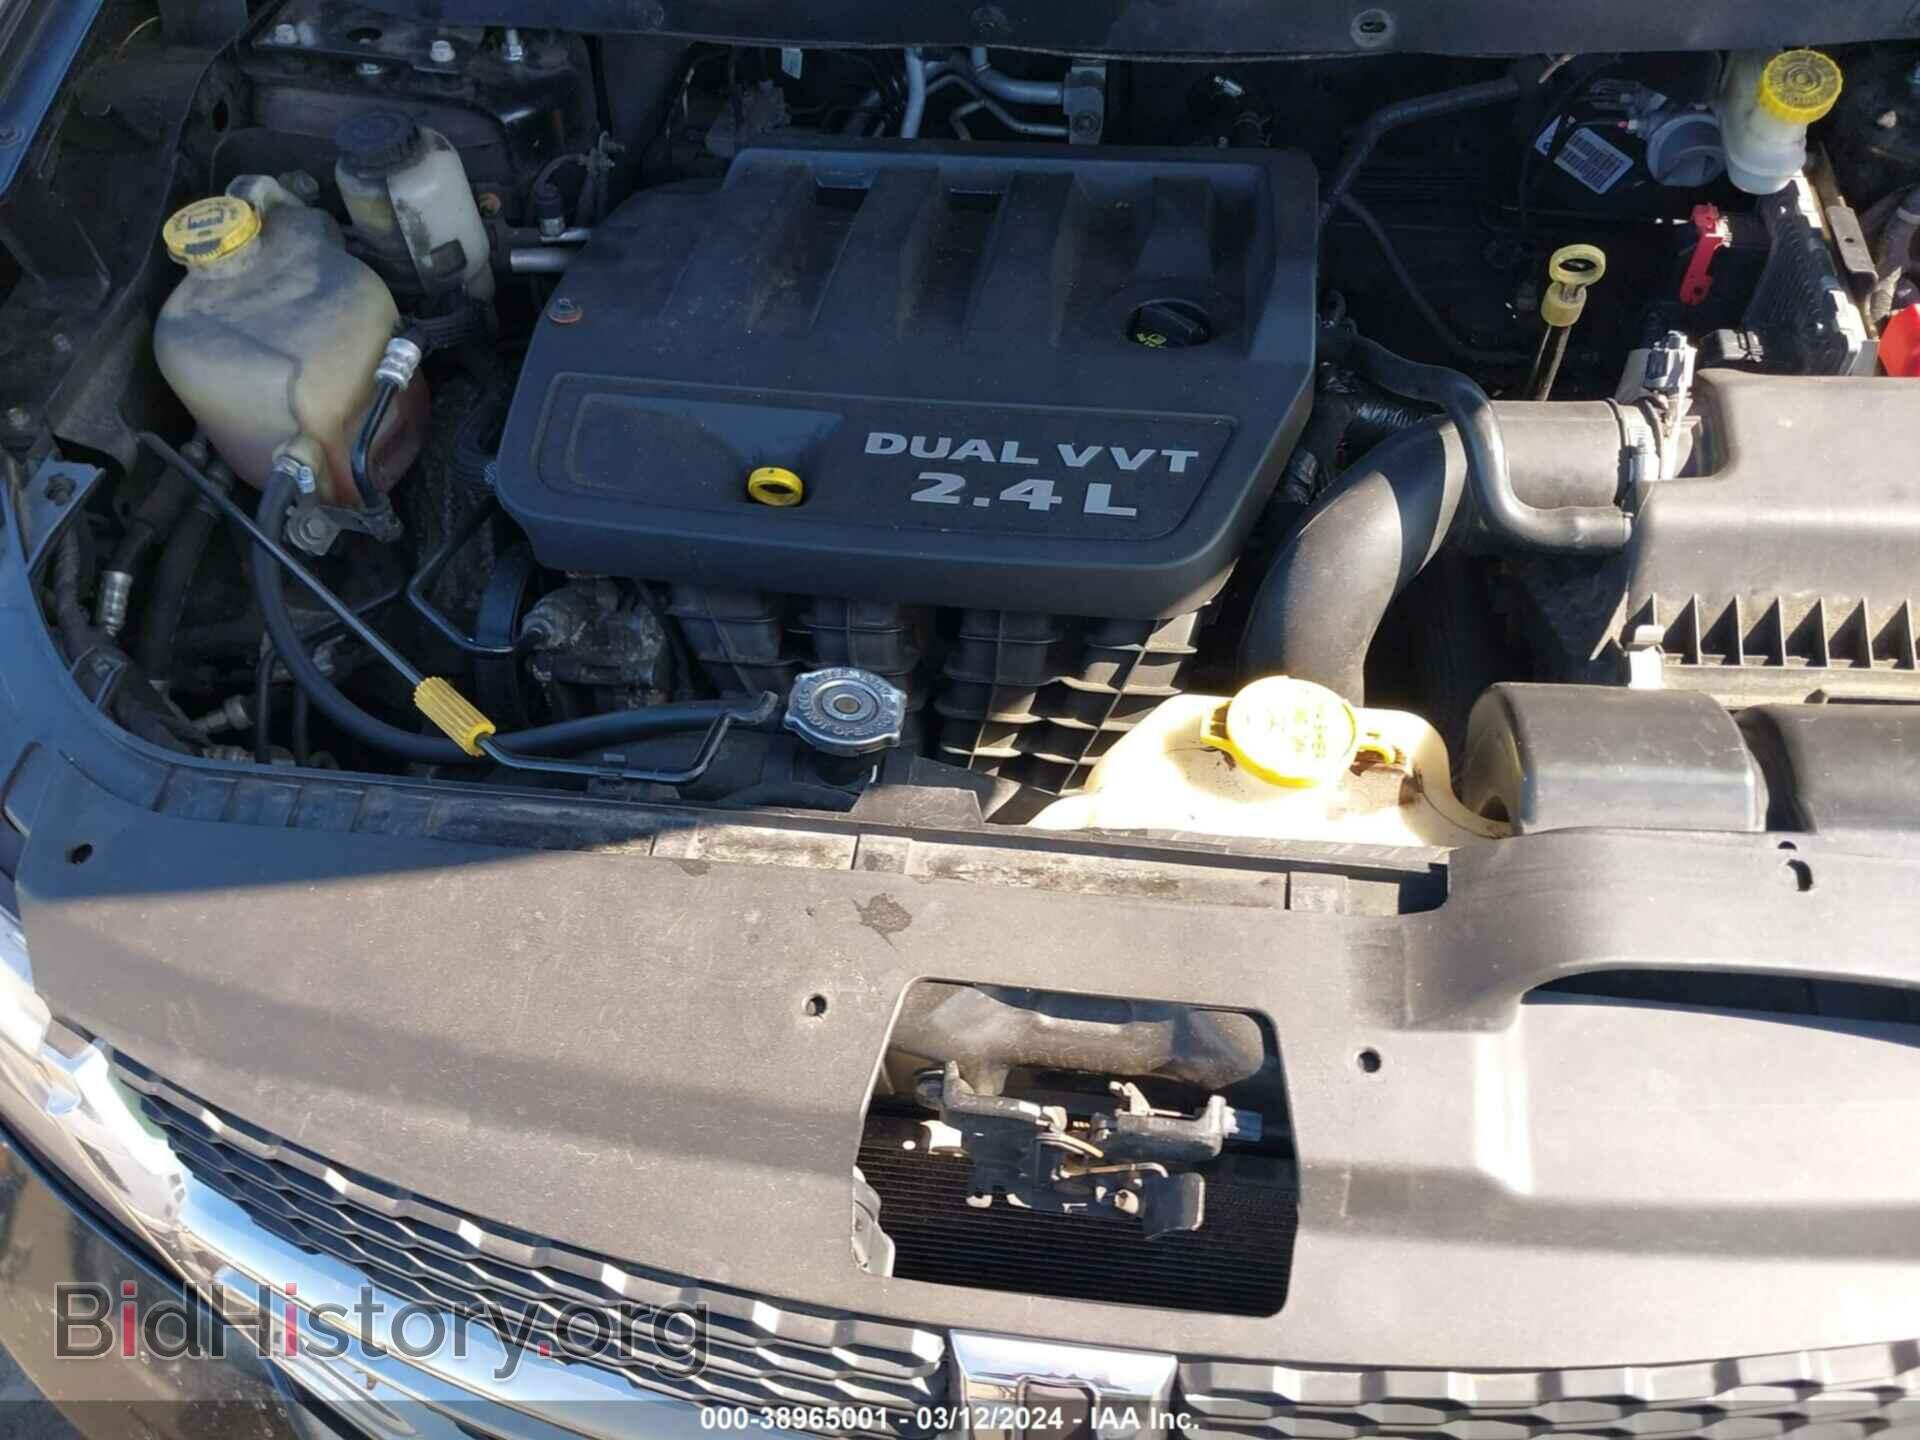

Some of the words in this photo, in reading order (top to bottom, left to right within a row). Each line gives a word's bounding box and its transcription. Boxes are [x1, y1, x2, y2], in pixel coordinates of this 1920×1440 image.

[864, 432, 1039, 465] DUAL
[1056, 444, 1199, 473] VVT
[832, 726, 875, 737] OPEN
